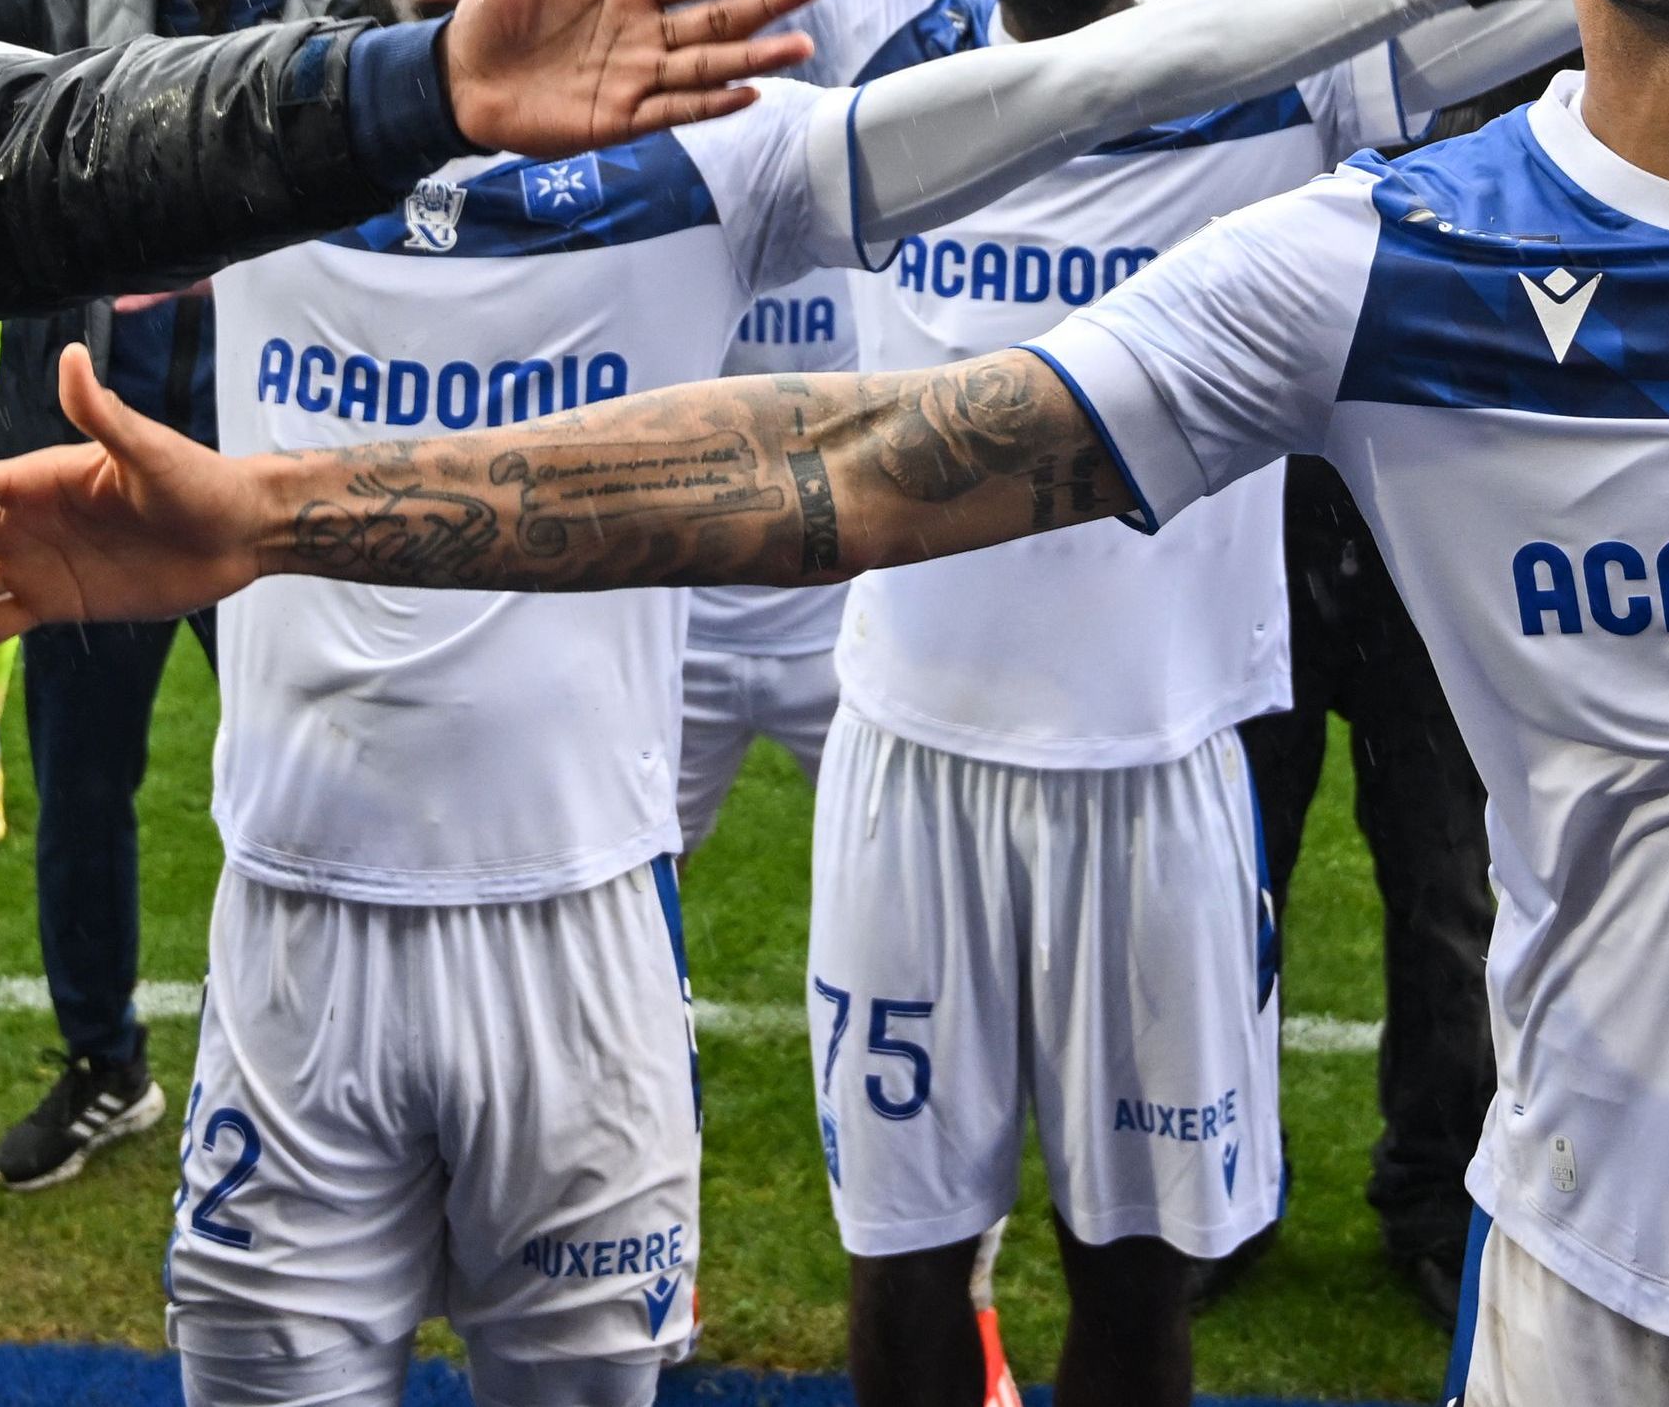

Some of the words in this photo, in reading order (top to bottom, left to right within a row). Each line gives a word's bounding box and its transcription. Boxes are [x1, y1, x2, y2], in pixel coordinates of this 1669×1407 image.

[899, 235, 1160, 306] ACADOM
[258, 337, 629, 429] ACADOMIA
[815, 976, 935, 1122] 75
[522, 1224, 683, 1279] AUXERRE
